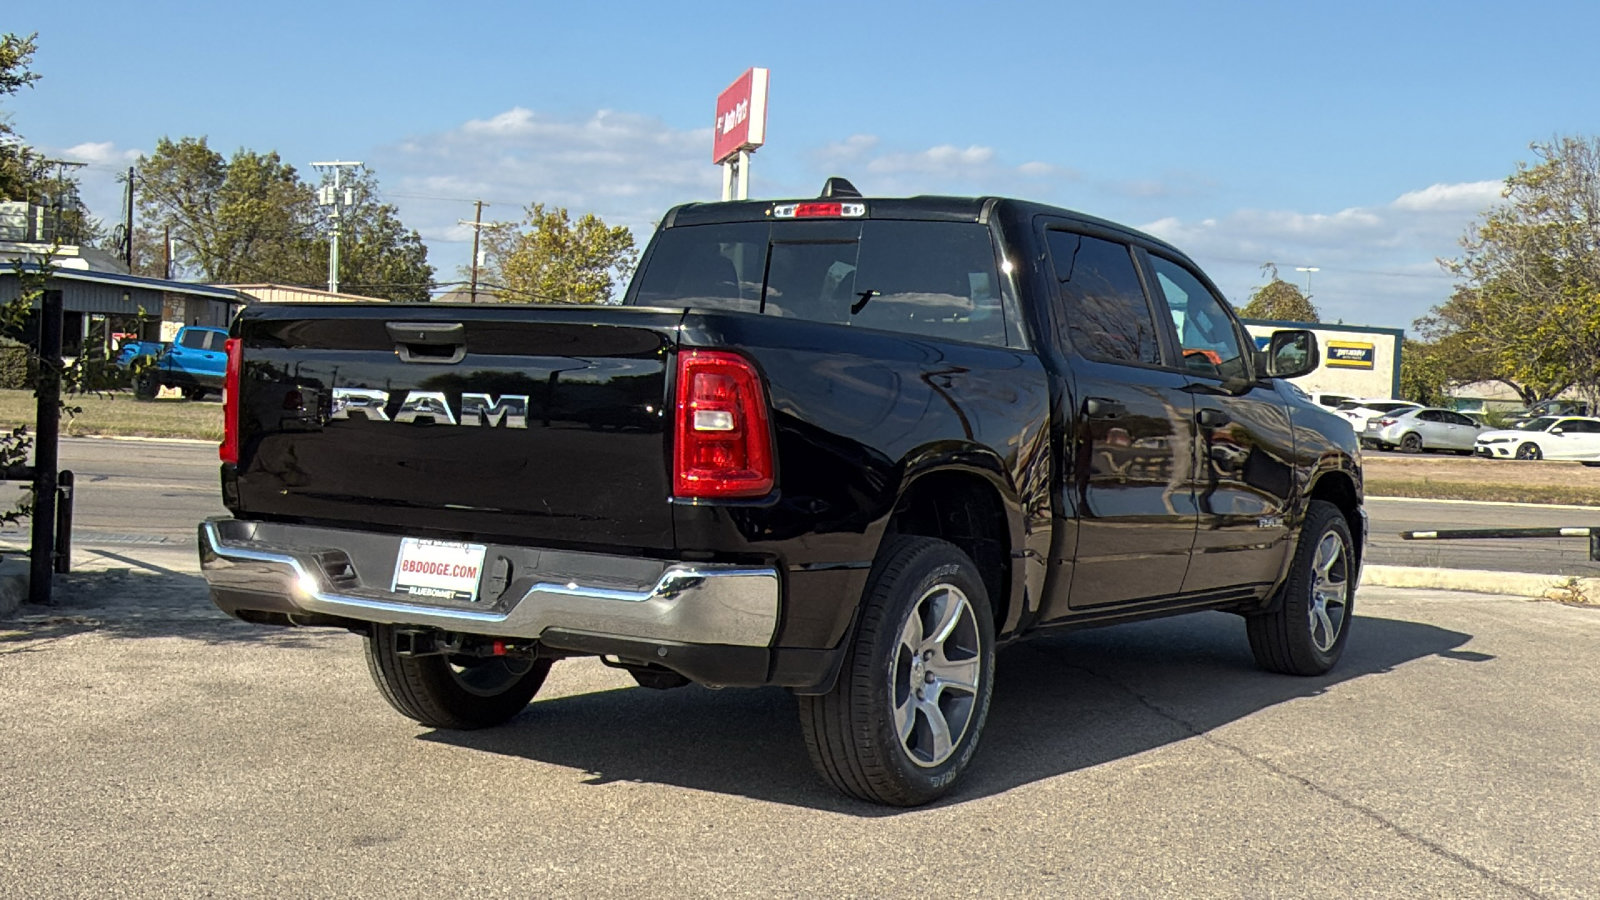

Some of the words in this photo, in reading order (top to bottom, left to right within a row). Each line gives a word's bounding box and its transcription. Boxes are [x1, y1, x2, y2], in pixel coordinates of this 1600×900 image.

[735, 98, 748, 127] Parts
[332, 387, 529, 429] RAM
[402, 559, 477, 579] BBDODGE.COM
[408, 586, 456, 600] BLUEBONNET
